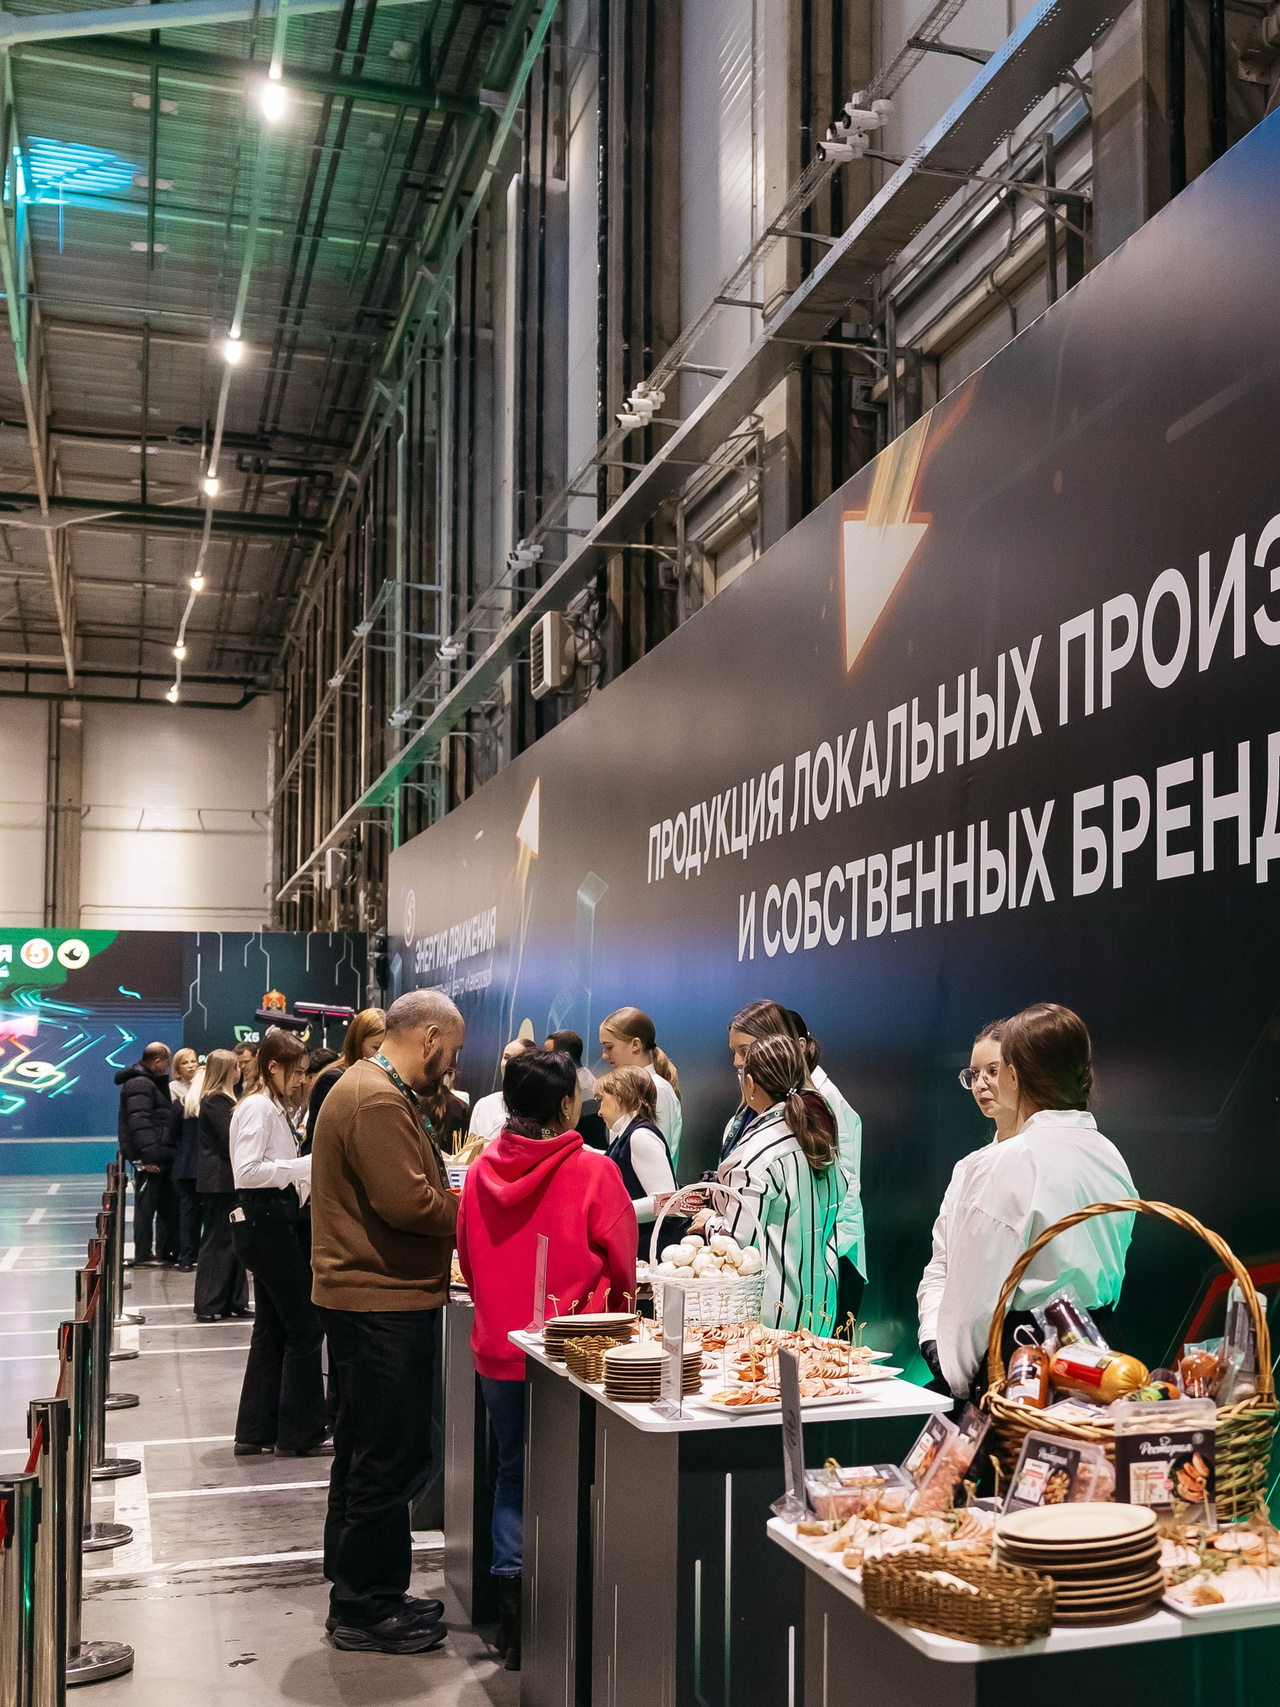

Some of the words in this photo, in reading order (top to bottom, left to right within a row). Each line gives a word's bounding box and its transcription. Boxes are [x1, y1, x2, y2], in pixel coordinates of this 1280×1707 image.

[647, 763, 784, 884] ПРОДУКЦИЯ
[790, 634, 1043, 832] ЛОКАЛЬНЫХ
[415, 929, 449, 974] ЭНЕРГИЯ
[447, 906, 497, 971] ДВИЖЕНИЯ
[738, 891, 756, 962] И
[762, 800, 1056, 958] СОБСТВЕННЫХ
